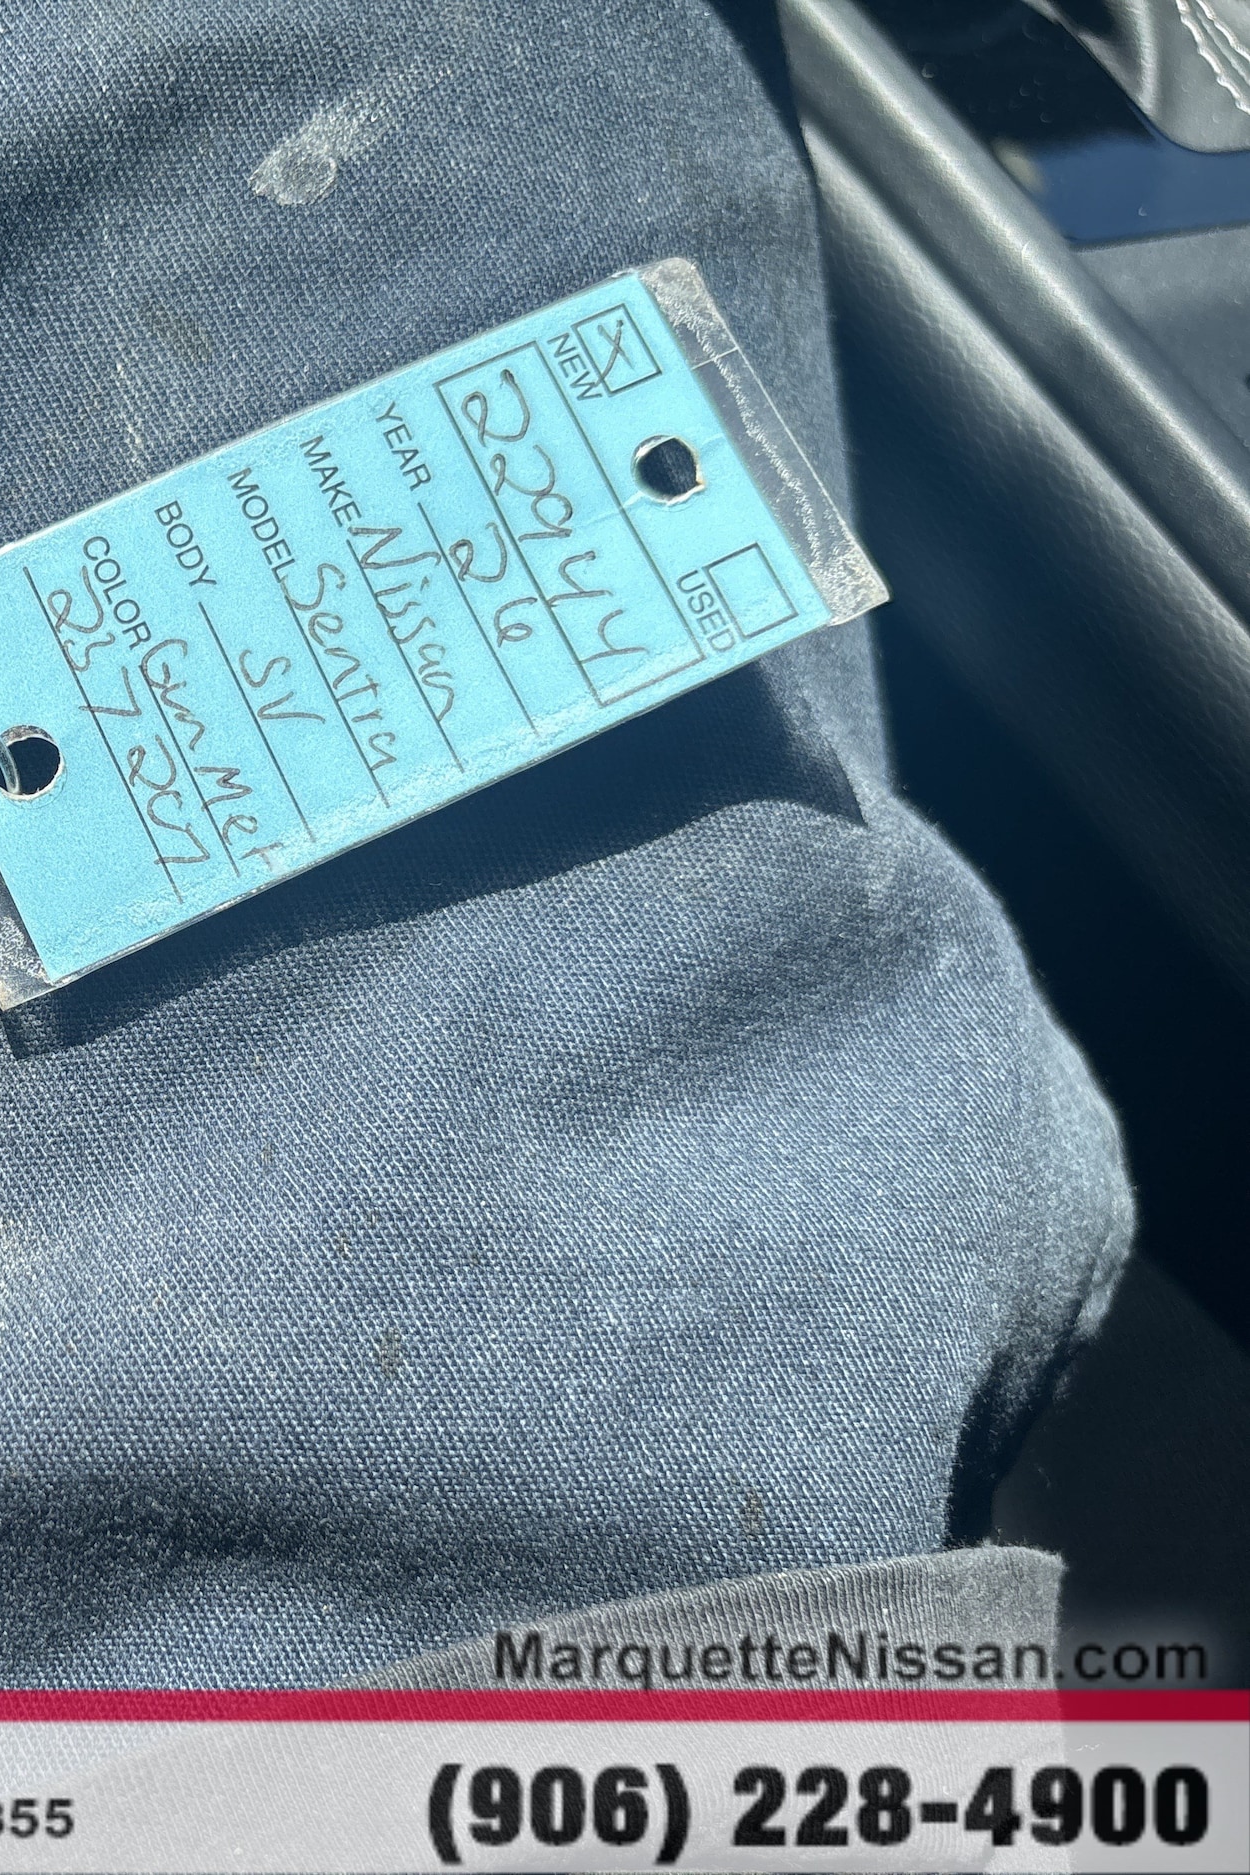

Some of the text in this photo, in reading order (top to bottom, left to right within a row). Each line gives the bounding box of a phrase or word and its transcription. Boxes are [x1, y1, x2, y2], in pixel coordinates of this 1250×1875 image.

[548, 333, 602, 401] NEW
[301, 435, 362, 527] MAKE
[375, 402, 432, 492] YEAR
[154, 500, 217, 588] BODY
[227, 467, 296, 583] MODEL
[83, 536, 152, 650] COLOR
[348, 526, 454, 722] Nissan
[450, 522, 537, 648] 26
[676, 570, 737, 653] USED
[141, 638, 206, 751] Gun
[239, 649, 325, 725] SV
[279, 562, 398, 772] Sentra
